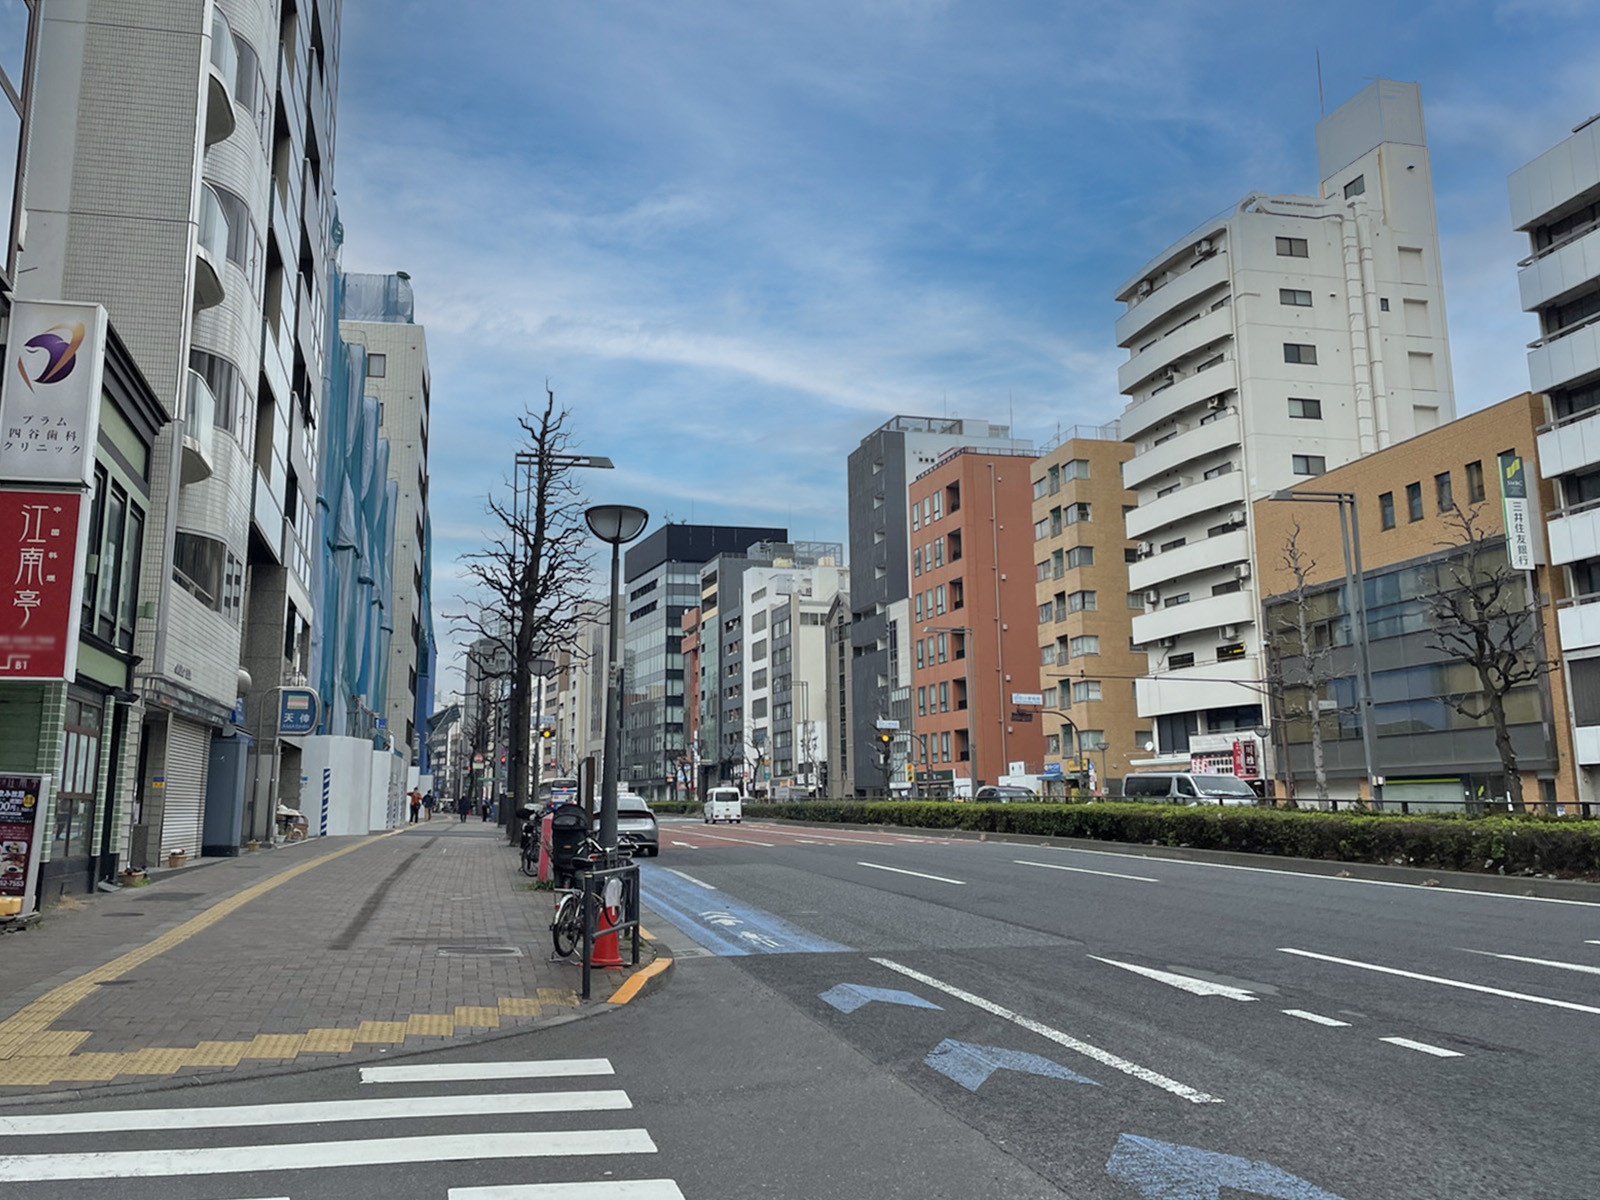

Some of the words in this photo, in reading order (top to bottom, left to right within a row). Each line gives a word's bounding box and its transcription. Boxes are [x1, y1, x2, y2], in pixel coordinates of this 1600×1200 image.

[9, 428, 77, 442] 四谷歯科
[3, 441, 80, 455] クリニック
[1513, 501, 1529, 566] 三井住友銀行
[13, 504, 50, 629] 江南亭
[15, 661, 28, 671] B1
